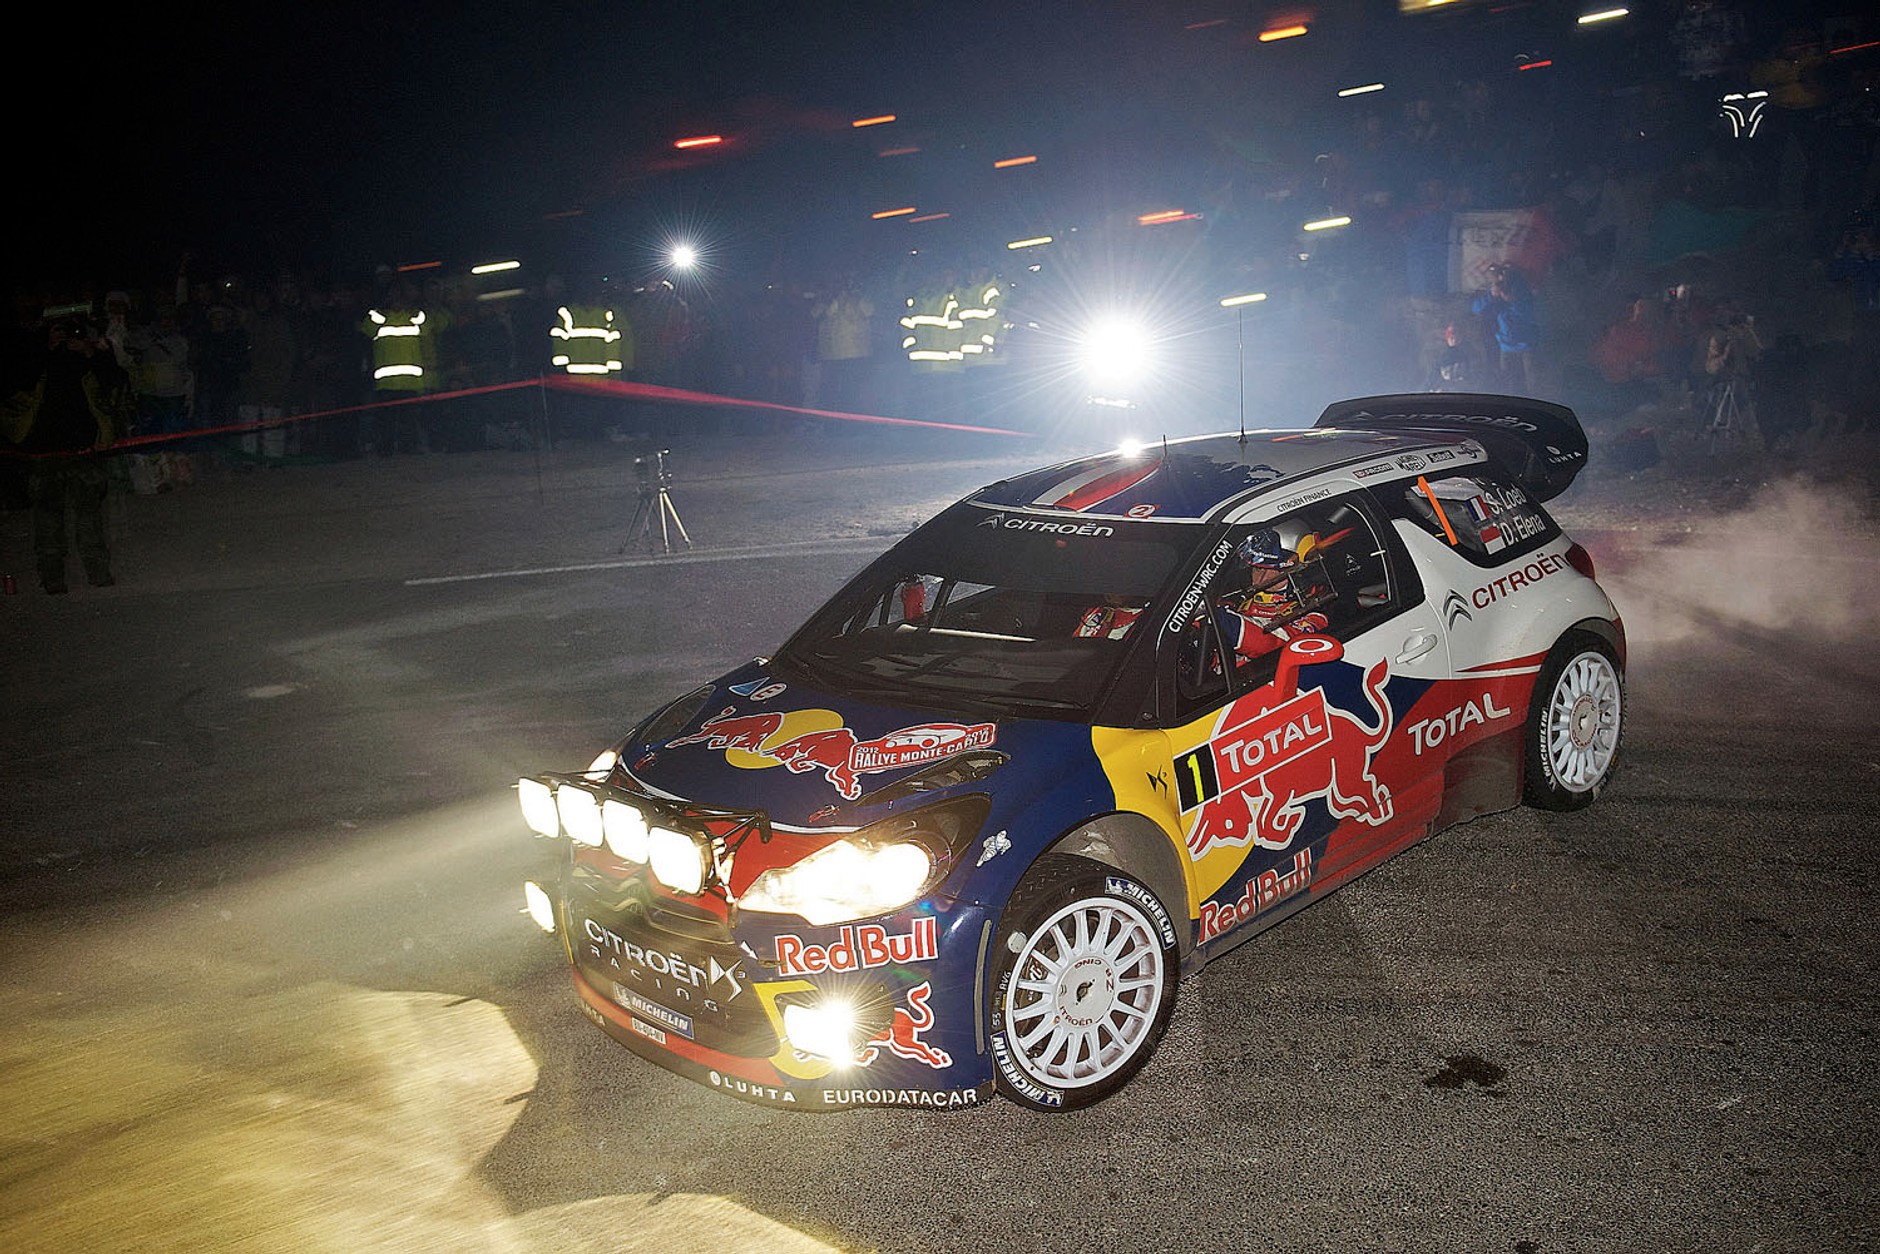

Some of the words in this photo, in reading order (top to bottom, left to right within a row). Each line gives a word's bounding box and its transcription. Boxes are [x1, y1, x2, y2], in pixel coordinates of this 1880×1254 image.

[1497, 483, 1527, 510] Loeb
[1003, 518, 1115, 537] CITROËN
[1500, 522, 1519, 546] D.
[1513, 514, 1547, 540] Elena
[1168, 540, 1234, 633] CITROEN-WRC.COM
[1472, 552, 1570, 609] CITROËN
[1220, 714, 1323, 774] TOTAL
[1407, 692, 1512, 756] TOTAL
[1540, 709, 1552, 778] MICHELIN
[854, 751, 898, 770] RALLYE
[1186, 753, 1205, 804] 1
[1126, 883, 1175, 944] MICHELIN
[1197, 876, 1257, 946] Red
[1257, 847, 1312, 907] Bull
[584, 918, 711, 992] CITROËN
[775, 926, 858, 976] Red
[858, 917, 938, 968] Bull
[590, 944, 719, 1012] RACING
[631, 997, 689, 1031] MICHELIN
[724, 1076, 797, 1103] LUHTA
[823, 1088, 978, 1106] EURODATACAR
[992, 1036, 1046, 1102] MICHELIN
